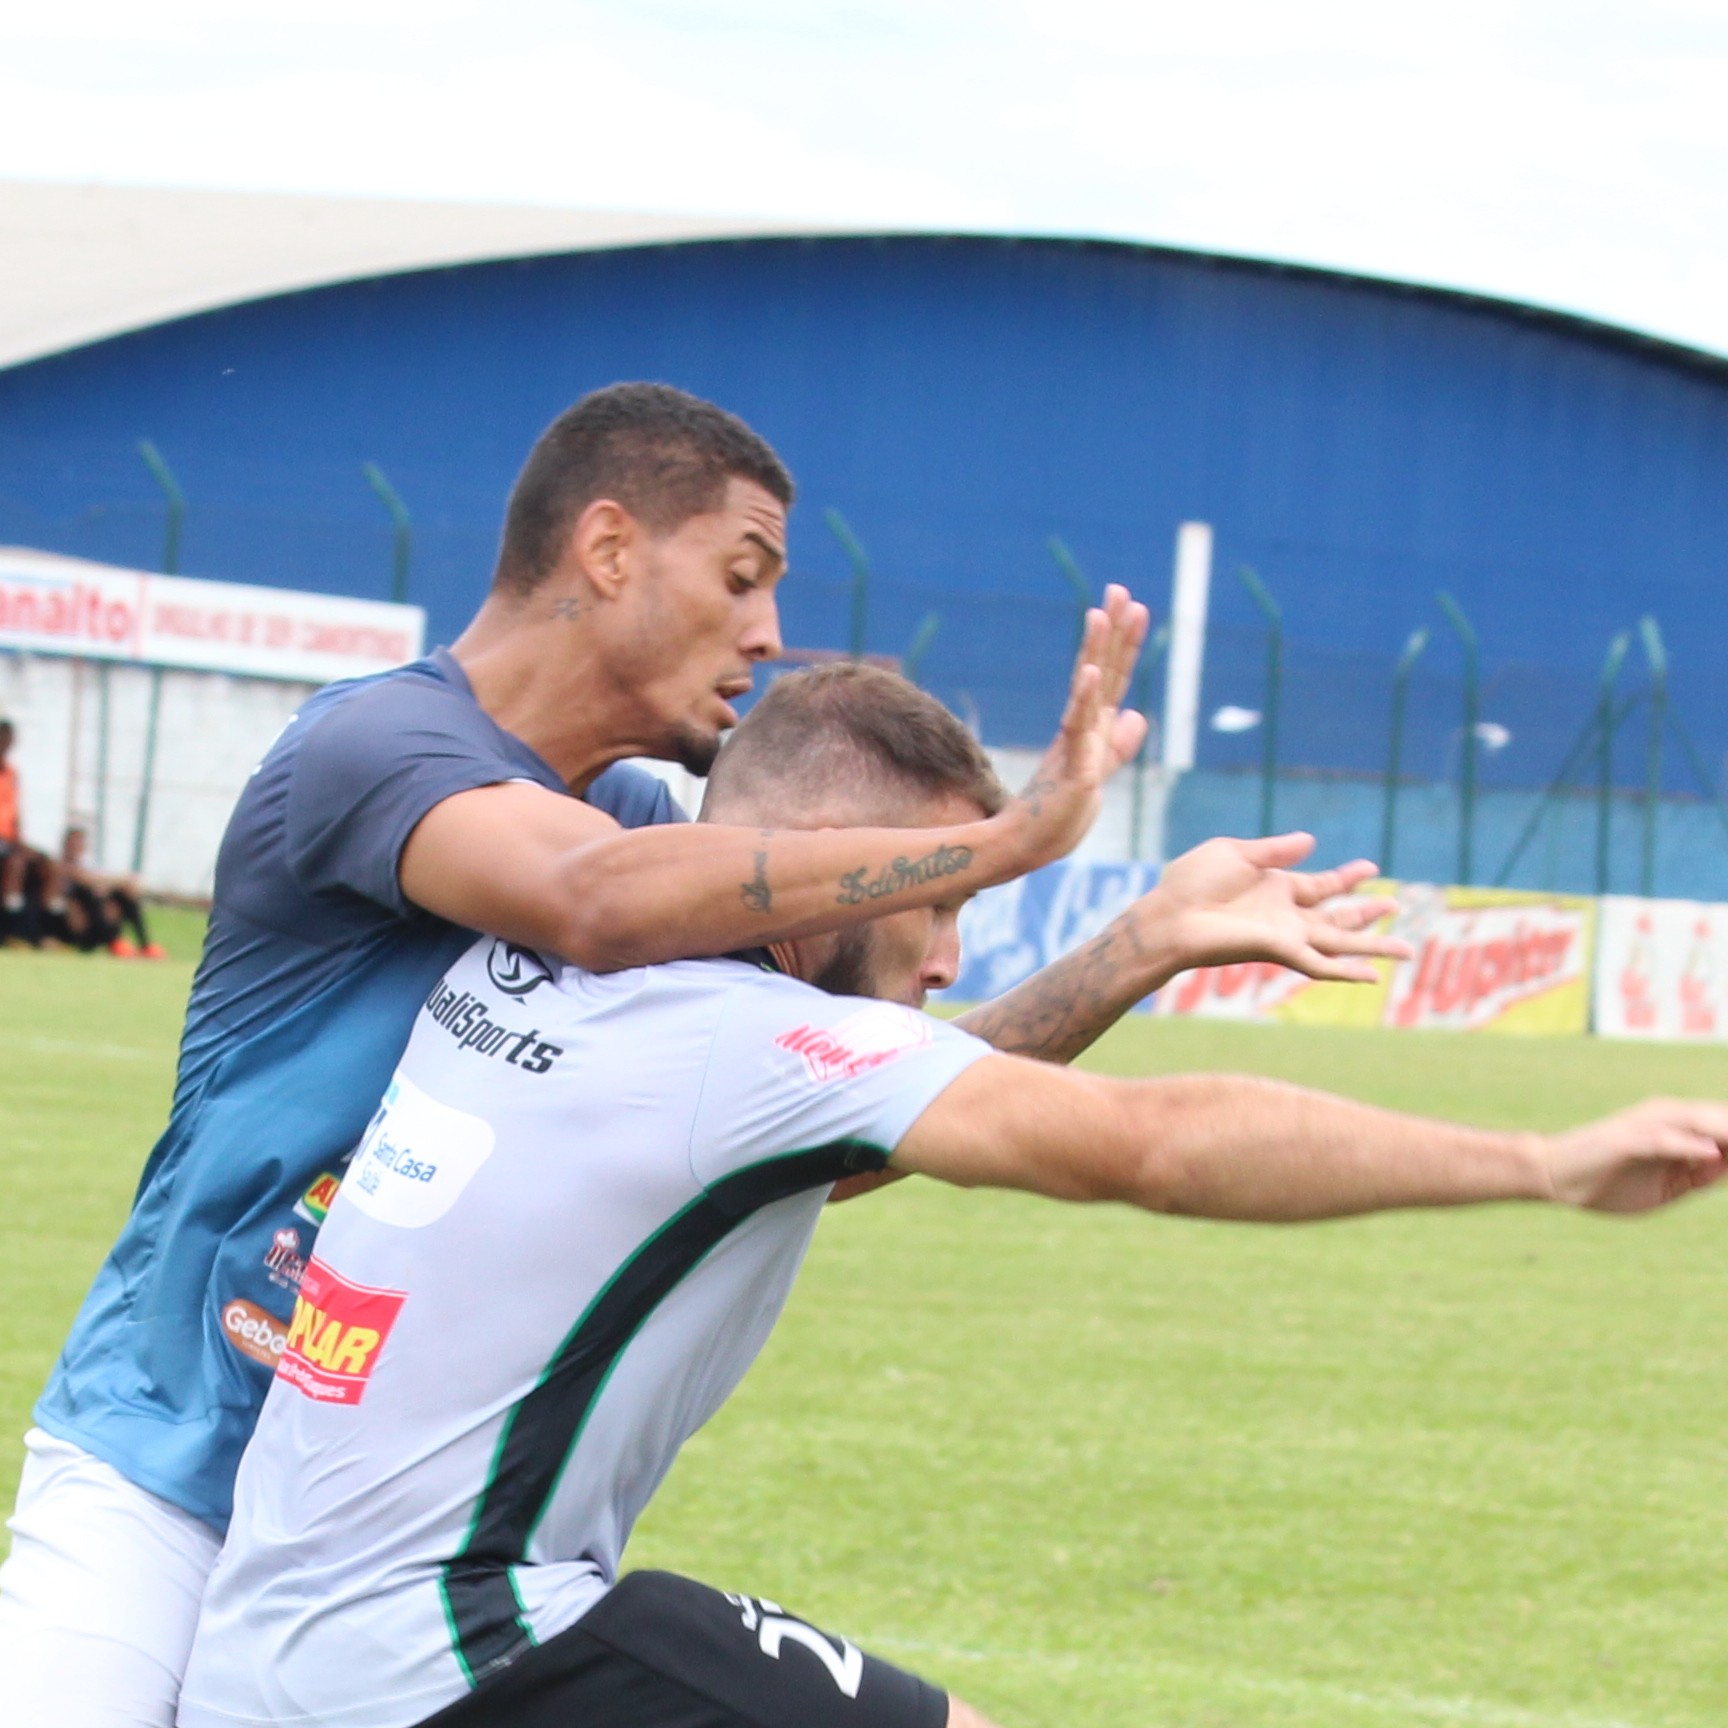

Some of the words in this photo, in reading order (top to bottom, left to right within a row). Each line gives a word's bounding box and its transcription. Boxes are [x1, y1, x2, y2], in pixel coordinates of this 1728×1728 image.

[425, 979, 564, 1075] ualiSports
[392, 1147, 439, 1183] Casa
[225, 1305, 288, 1354] Gebo
